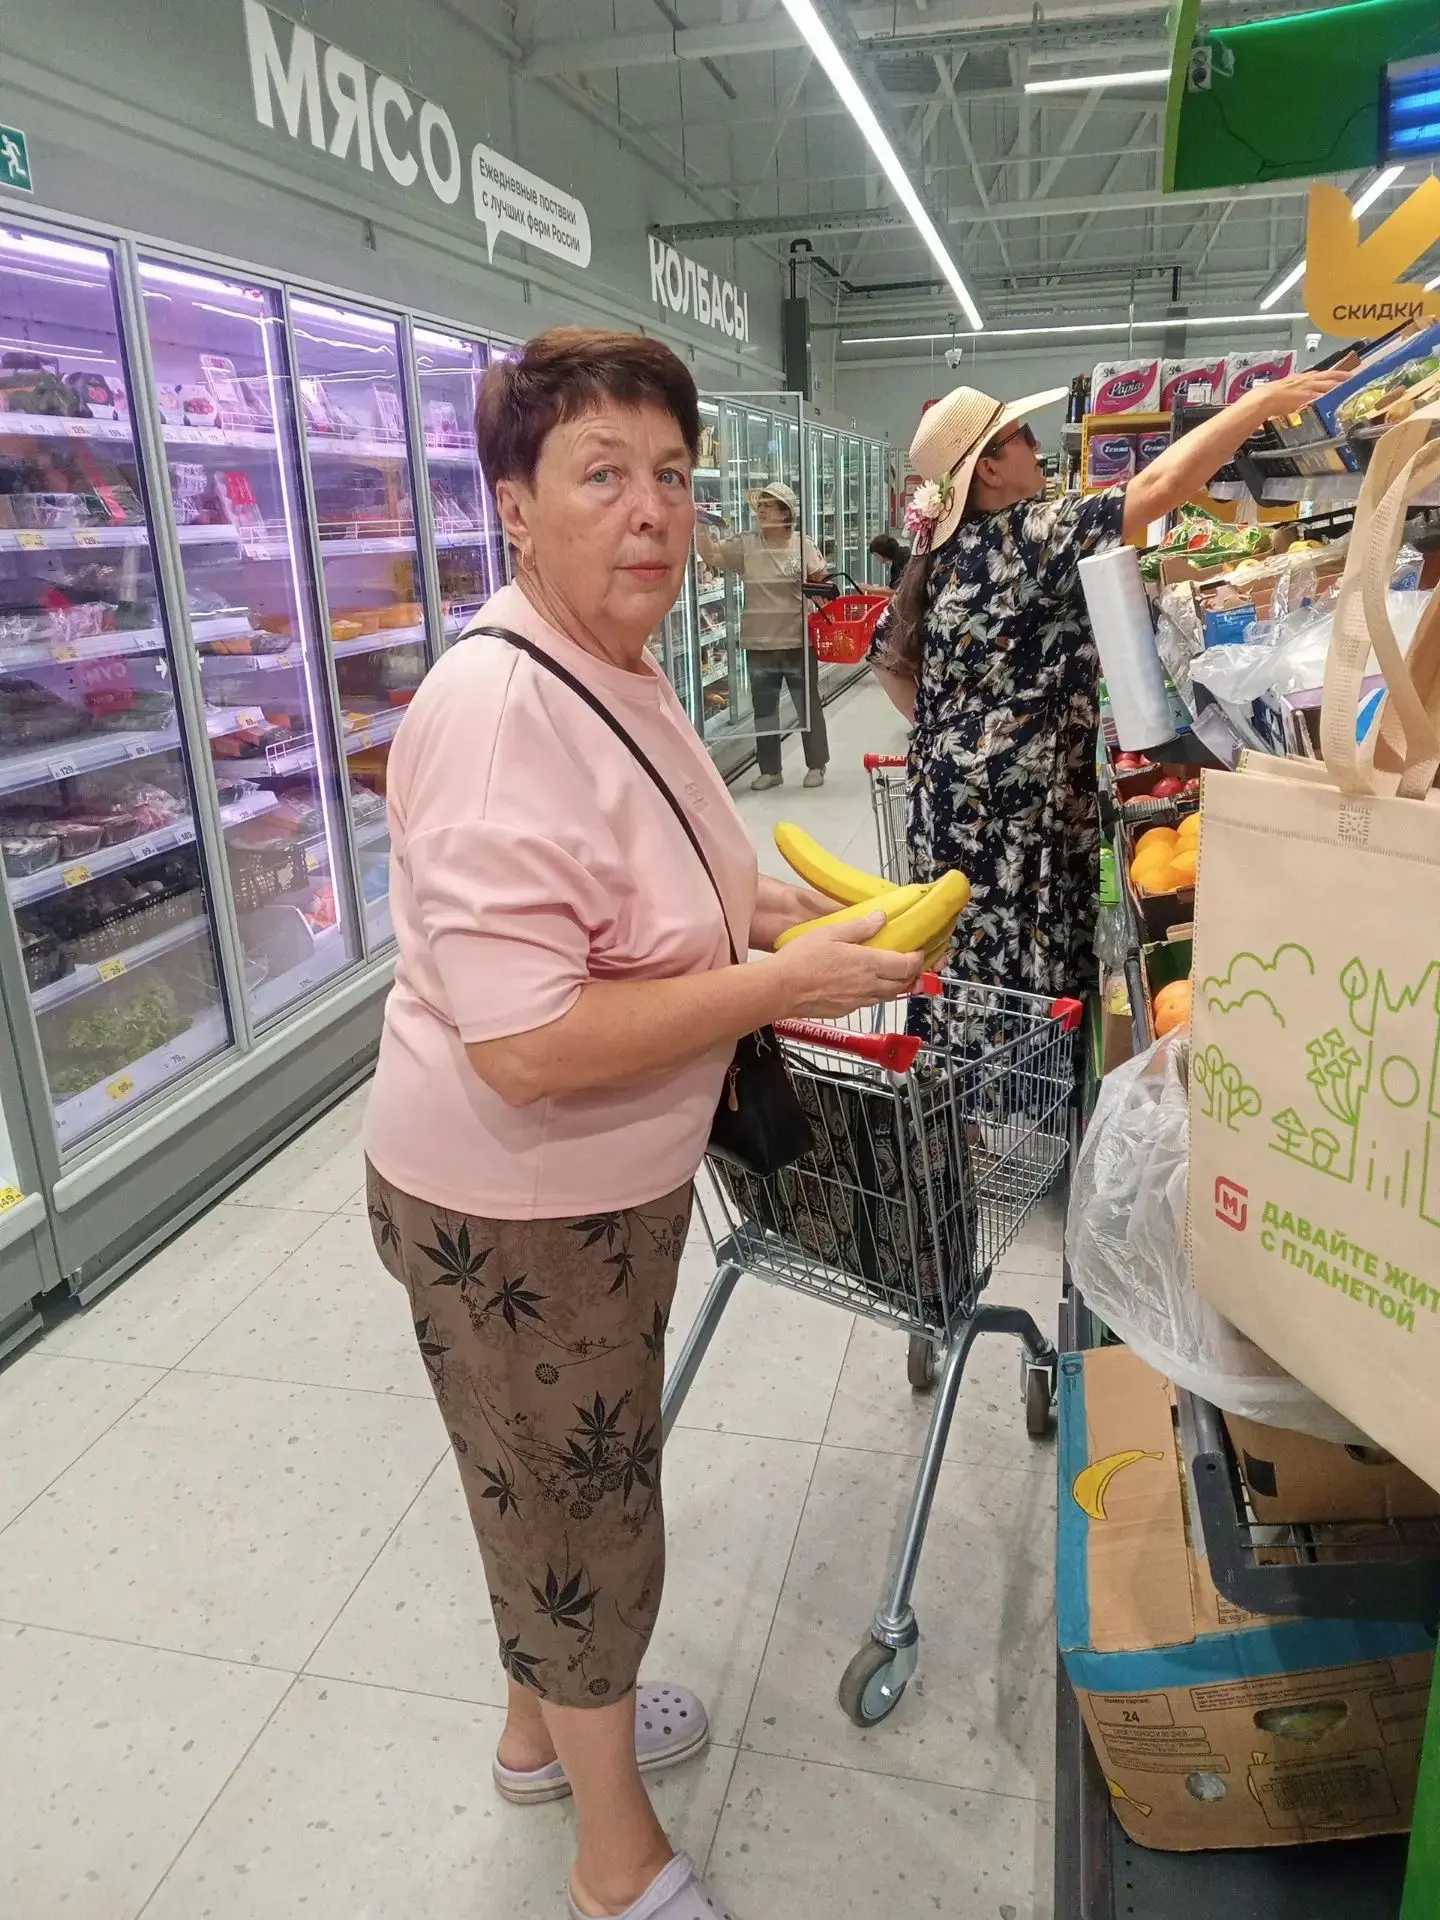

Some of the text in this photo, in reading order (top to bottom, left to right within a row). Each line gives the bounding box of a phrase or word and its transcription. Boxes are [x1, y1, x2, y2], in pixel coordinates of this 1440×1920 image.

[244, 0, 461, 204] МЯСО
[479, 157, 576, 225] Ежедневные поставки
[482, 190, 580, 253] с лучших ферм России
[648, 234, 749, 343] КОЛБАСЫ
[1333, 302, 1424, 321] СКИДКИ
[1110, 379, 1142, 397] Papia
[60, 766, 74, 776] 129
[775, 1020, 849, 1043] ЕНИИ МАГНИТ
[171, 1055, 181, 1065] 79
[1262, 1201, 1440, 1314] ДАВАЙТЕ ЖИТ
[1261, 1231, 1416, 1333] С ПЛАНЕТОЙ
[1122, 1711, 1140, 1722] 24
